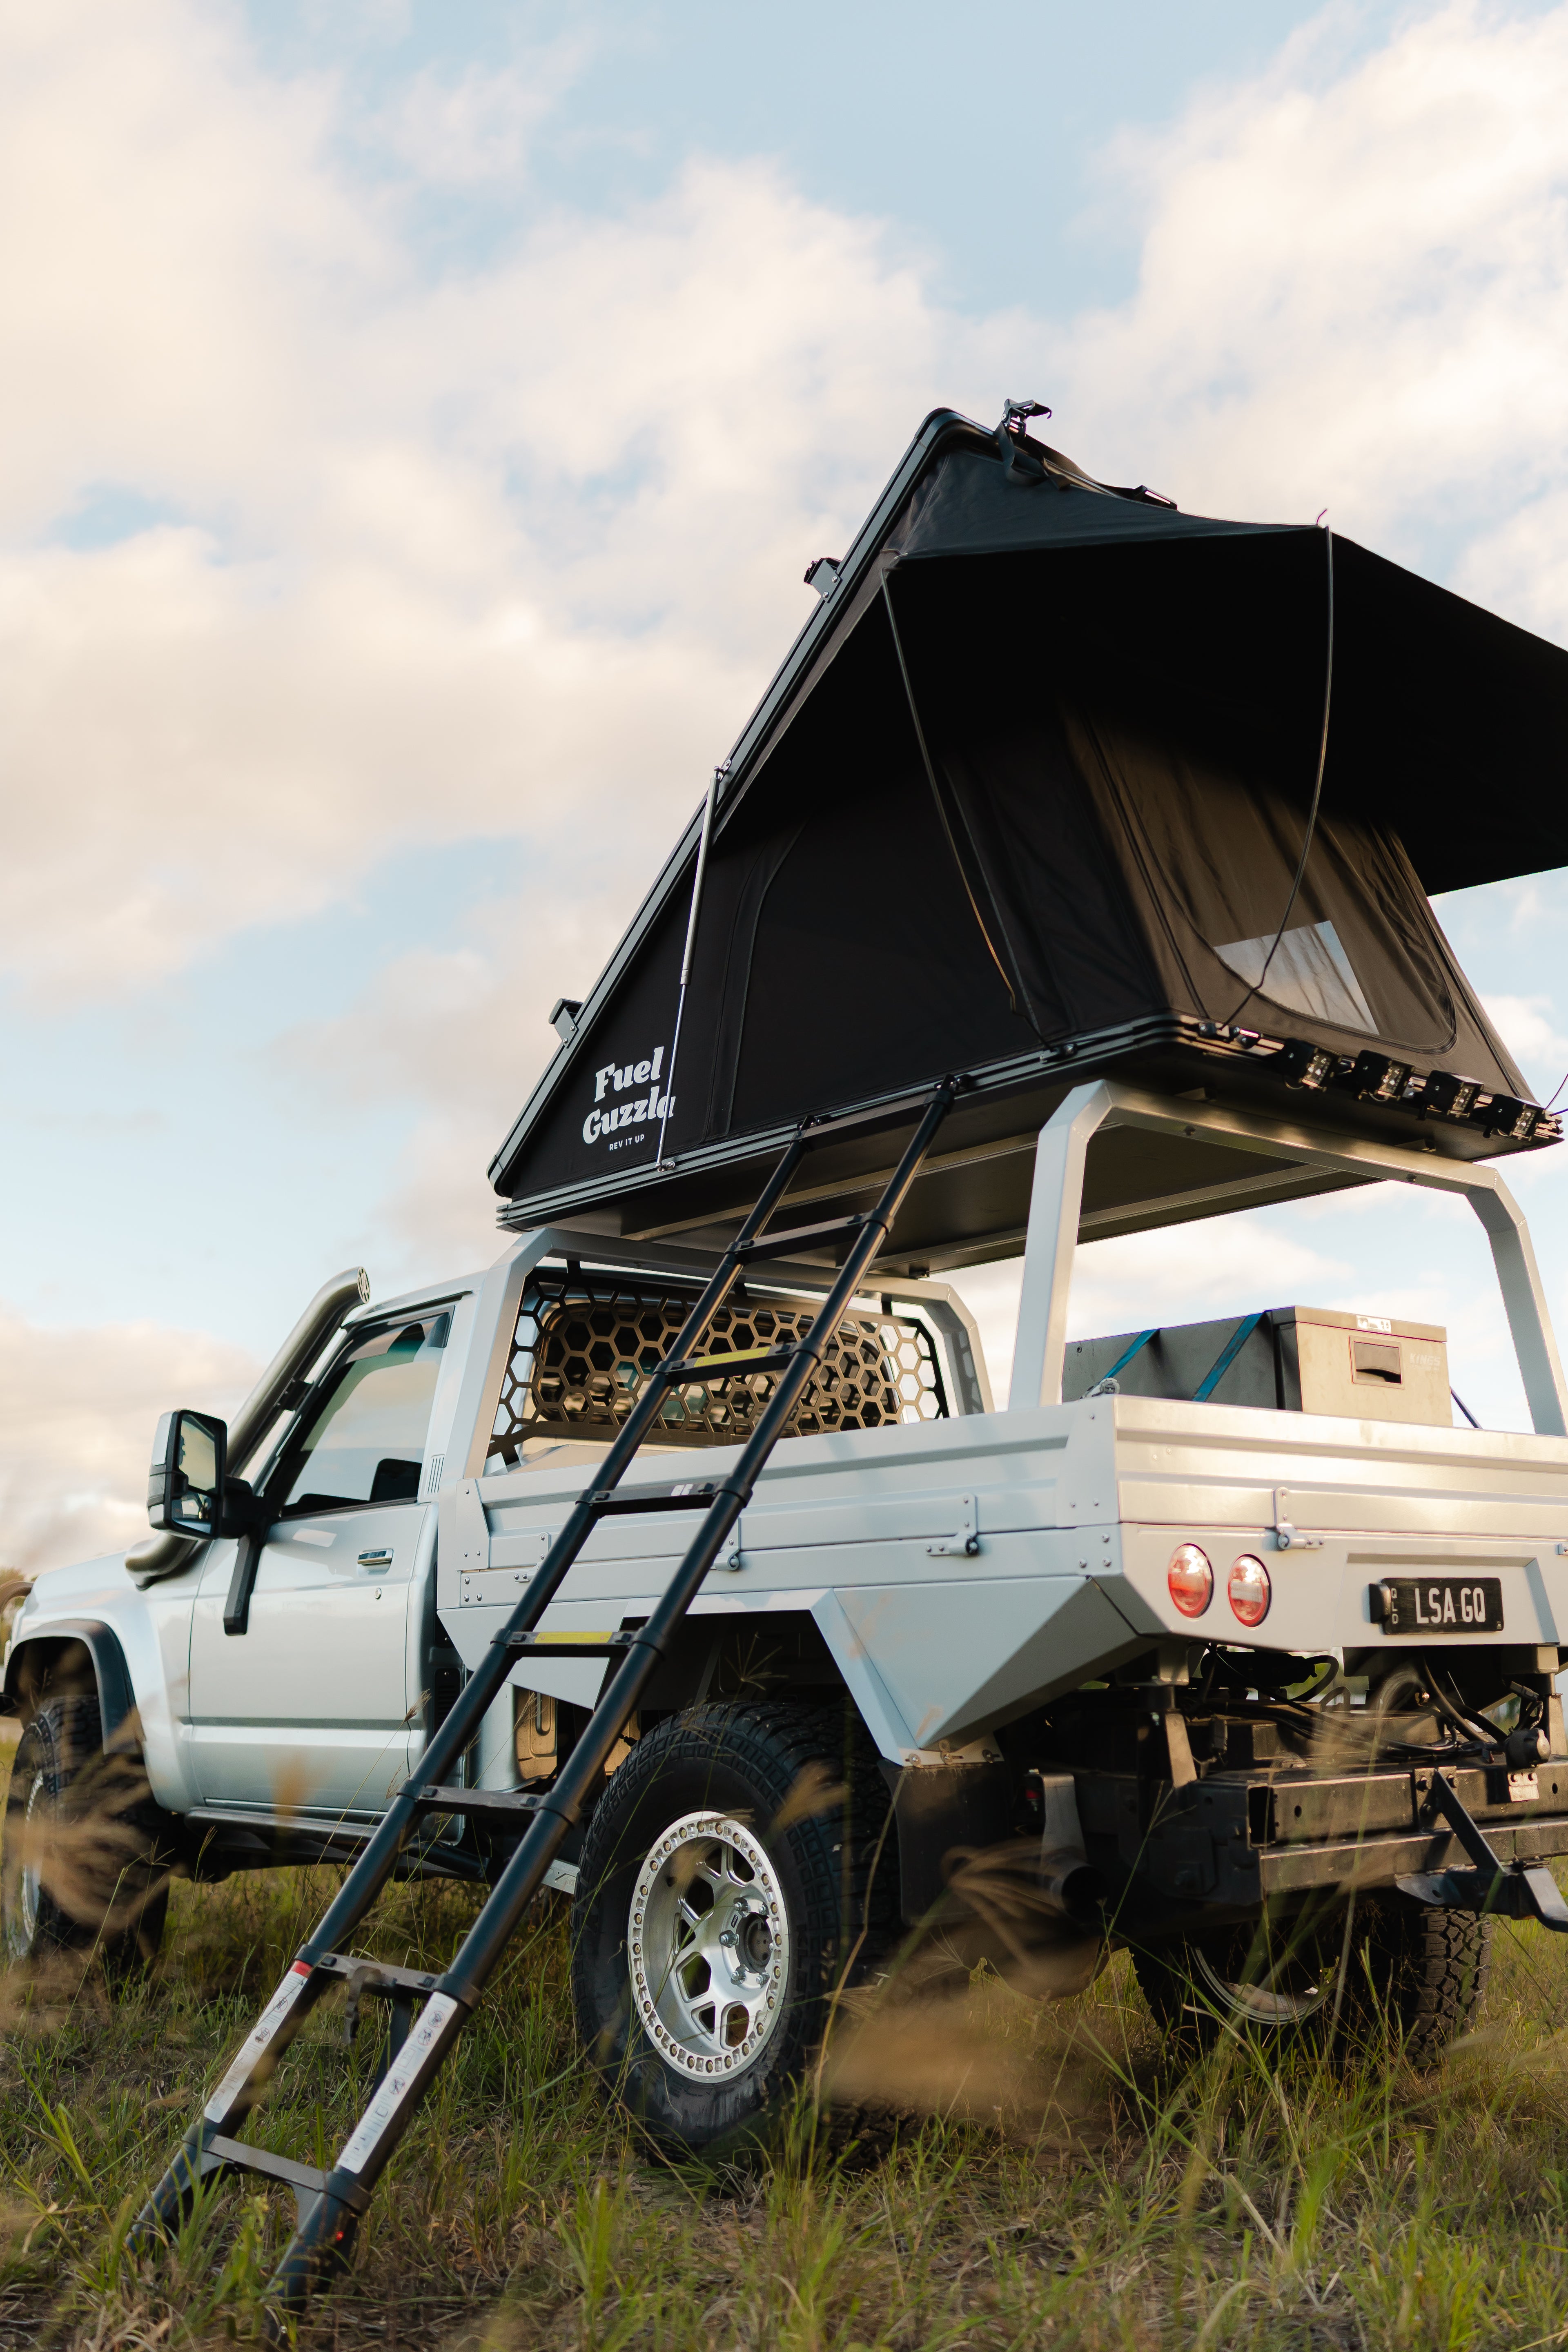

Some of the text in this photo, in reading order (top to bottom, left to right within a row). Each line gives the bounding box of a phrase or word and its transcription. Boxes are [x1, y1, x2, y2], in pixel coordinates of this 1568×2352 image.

[595, 1046, 664, 1102] Fuel
[583, 1085, 676, 1144] Guzzla
[609, 1134, 645, 1151] REV IT UP
[1410, 1353, 1441, 1366] KINGS
[1390, 1588, 1399, 1624] QLD
